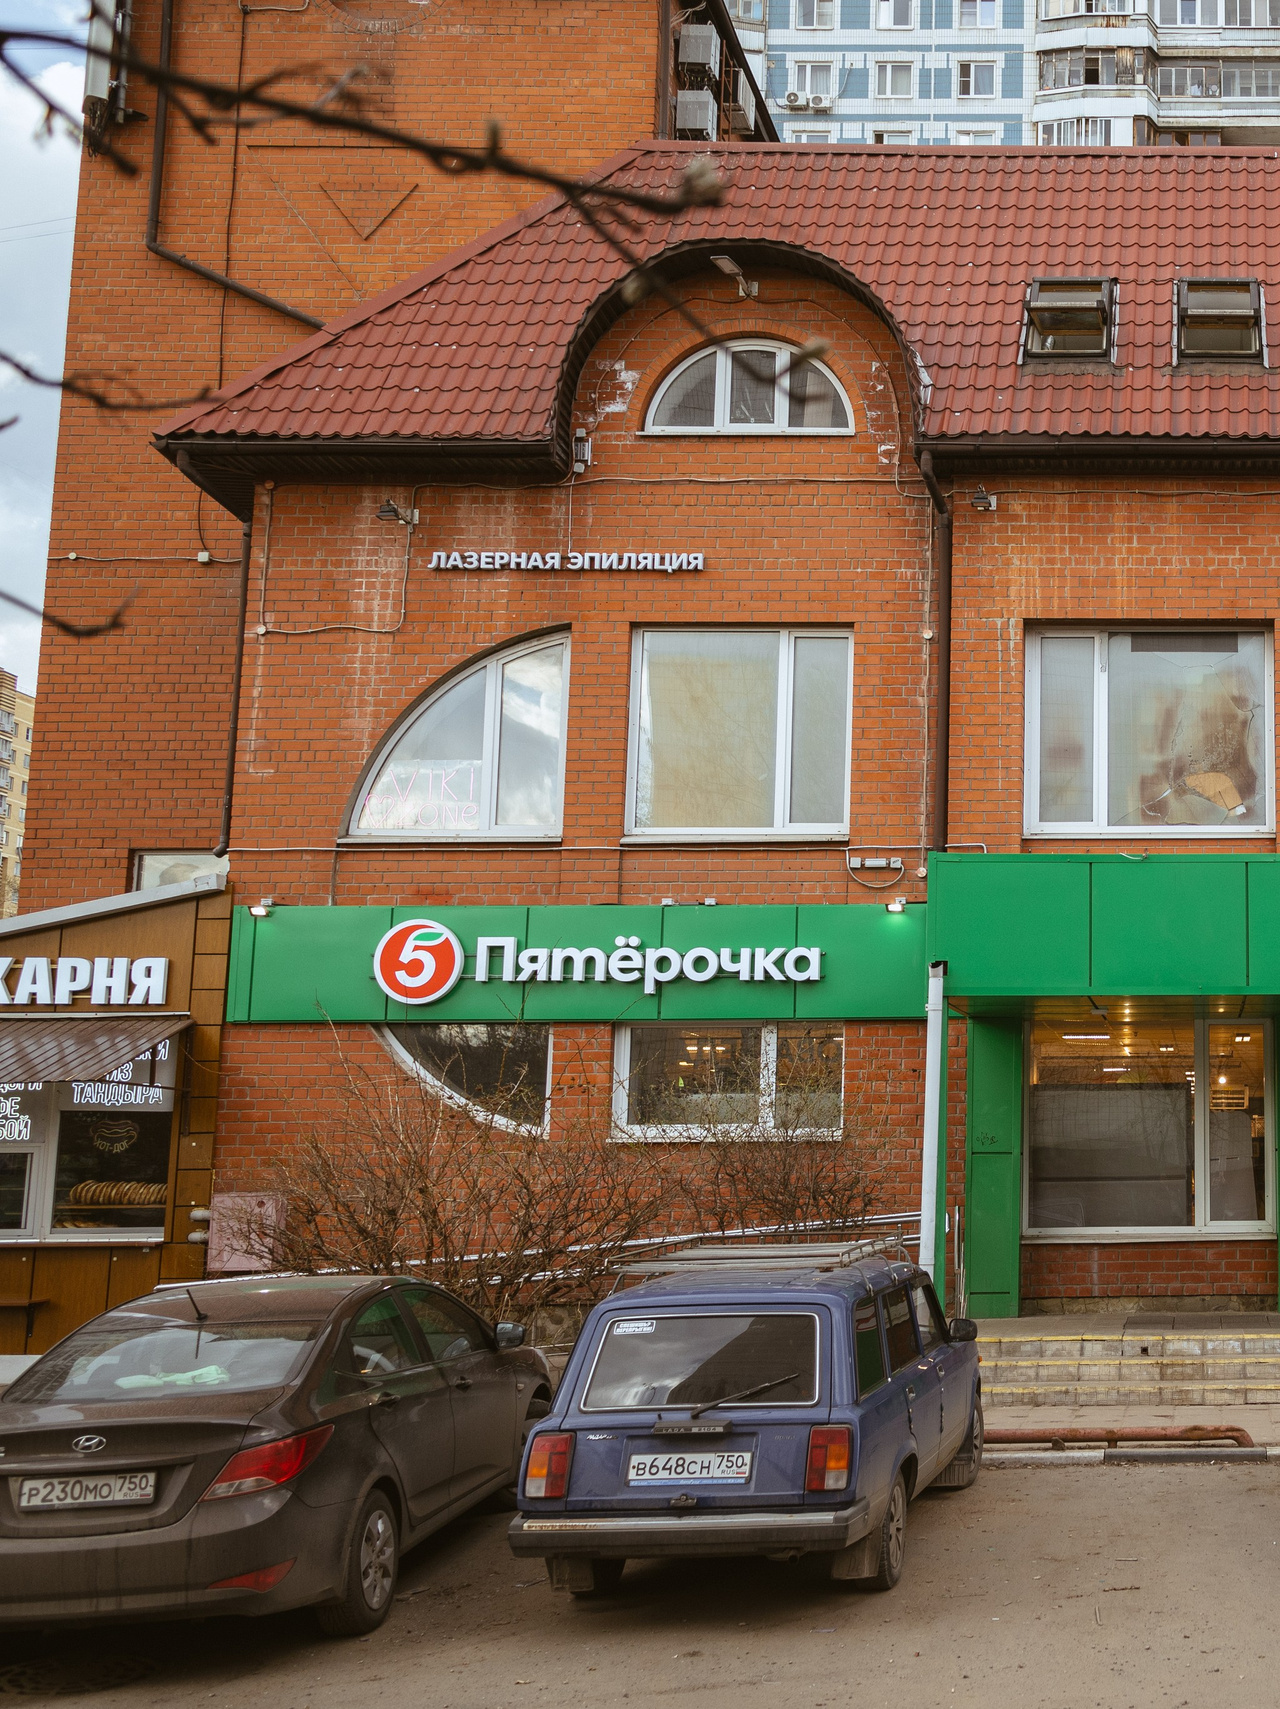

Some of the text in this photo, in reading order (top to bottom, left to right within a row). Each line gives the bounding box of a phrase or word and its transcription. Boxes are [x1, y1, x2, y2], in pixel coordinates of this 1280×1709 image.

[428, 551, 704, 573] ЛАЗЕРНАЯ ЭПИЛЯЦИЯ
[390, 768, 475, 802] VIKI
[474, 935, 822, 995] Пятёрочка
[72, 1082, 163, 1106] ТАНДЫРА
[716, 1454, 745, 1469] 750
[117, 1474, 149, 1492] 750
